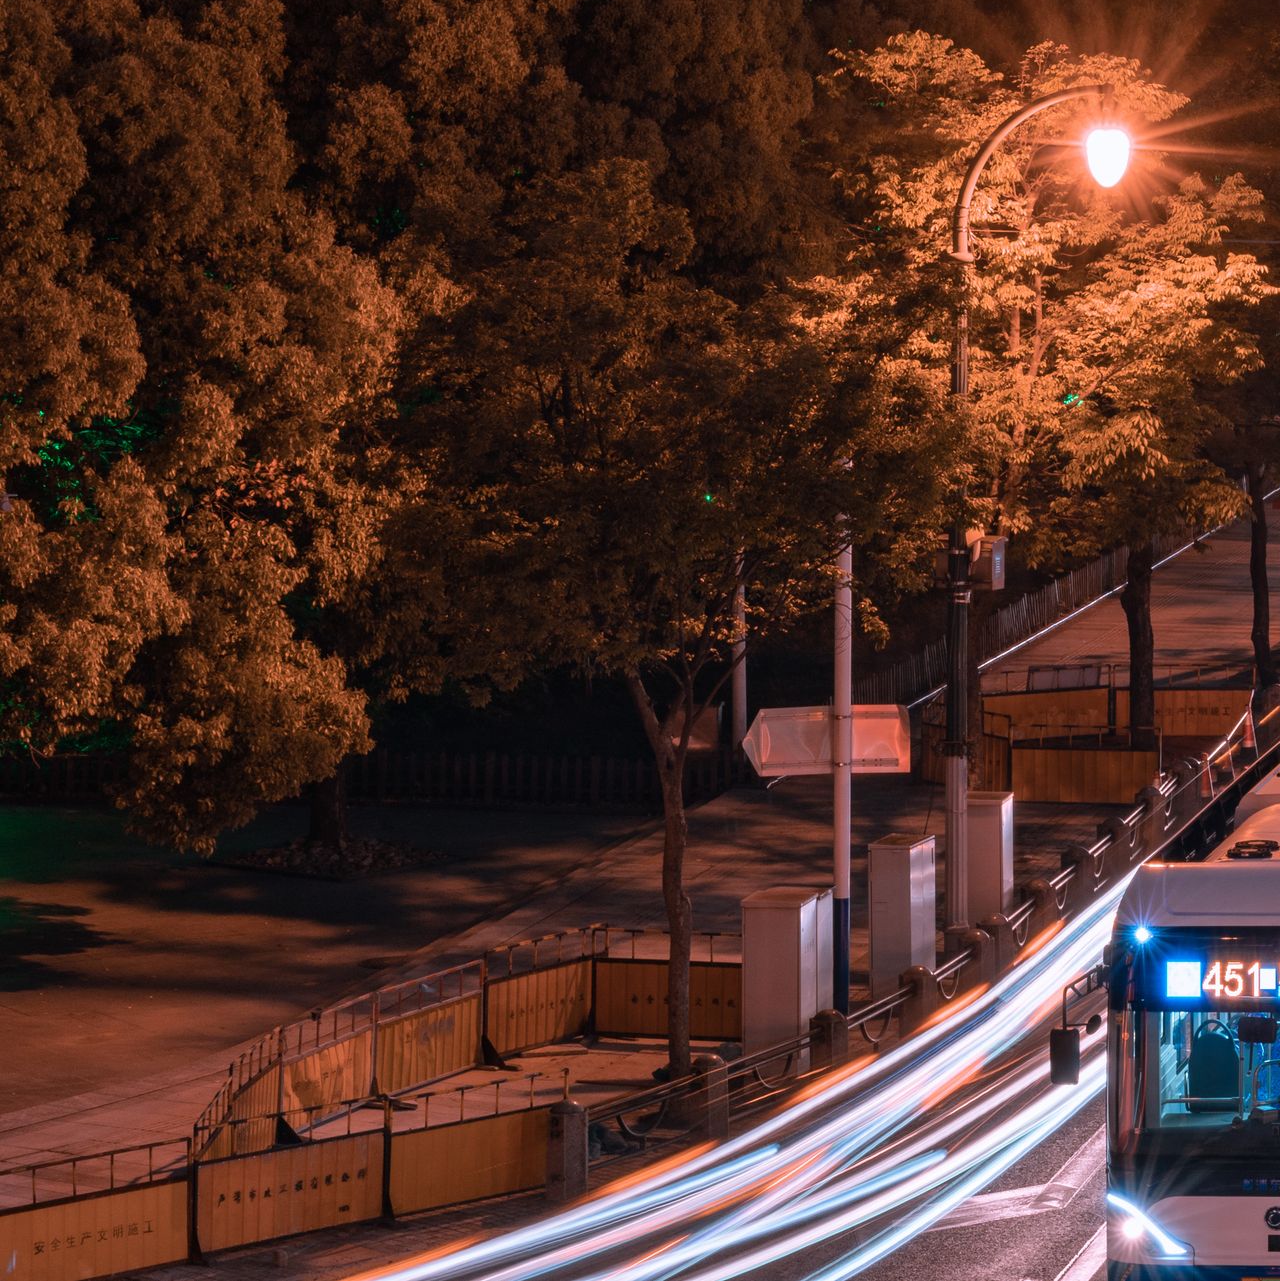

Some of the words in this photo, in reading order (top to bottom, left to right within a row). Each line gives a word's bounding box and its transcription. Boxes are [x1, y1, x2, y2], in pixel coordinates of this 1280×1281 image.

[1202, 961, 1261, 997] 451
[33, 1220, 155, 1255] 安全生产文明施工
